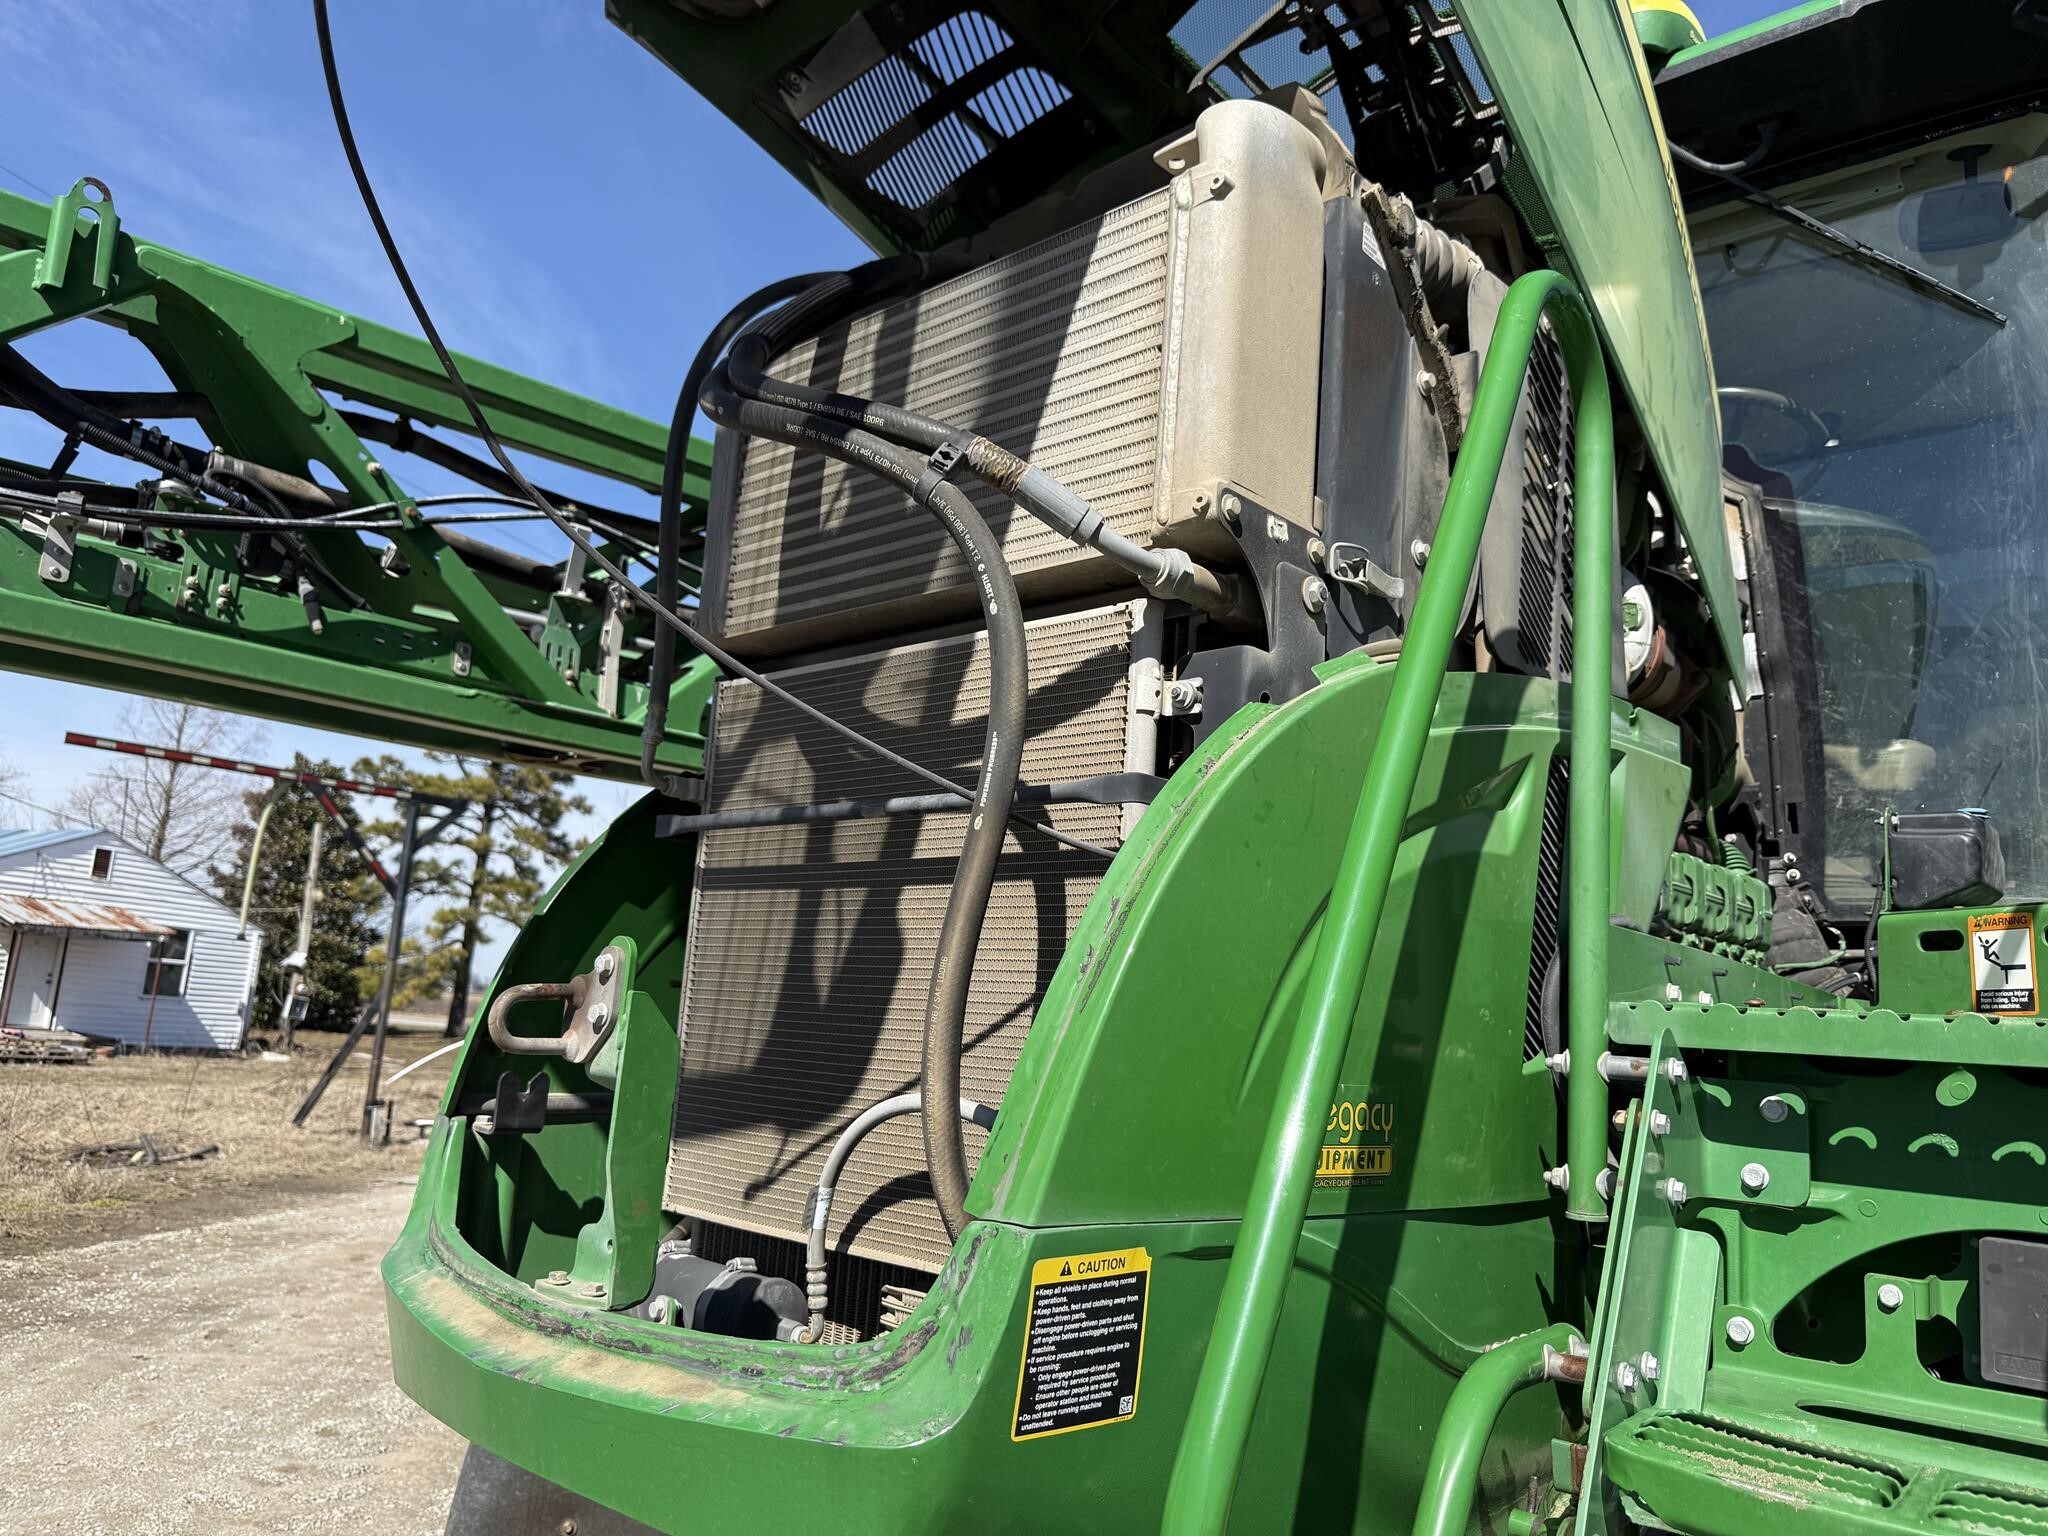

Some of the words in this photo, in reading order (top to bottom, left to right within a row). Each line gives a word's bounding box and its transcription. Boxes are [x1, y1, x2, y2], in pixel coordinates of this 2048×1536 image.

[849, 410, 862, 420] SAE
[862, 414, 884, 426] 100R6
[858, 445, 875, 460] Type
[873, 454, 892, 468] 4079
[890, 462, 904, 474] ISO
[942, 504, 958, 521] PSI)
[951, 518, 968, 536] (300
[961, 533, 977, 550] MPa
[979, 771, 991, 807] POWERING
[1984, 916, 2027, 926] WARNING
[936, 955, 948, 984] 100R6
[933, 986, 942, 1002] SAE
[930, 1010, 938, 1022] R6
[924, 1092, 934, 1114] 4079
[1327, 1102, 1393, 1143] egacy
[1318, 1150, 1385, 1170] IPMENT
[1078, 1257, 1126, 1274] CAUTION
[1040, 1288, 1053, 1296] Keep
[1062, 1285, 1081, 1293] shields
[1088, 1282, 1102, 1290] place
[1103, 1280, 1119, 1288] during
[1120, 1276, 1136, 1284] normal
[1037, 1308, 1051, 1316] Keep
[1052, 1305, 1070, 1313] hands,
[1081, 1301, 1091, 1309] and
[1092, 1299, 1113, 1308] clothing
[1038, 1296, 1068, 1306] operations.
[1035, 1315, 1071, 1326] power-driven
[1072, 1312, 1086, 1321] parts.
[1035, 1325, 1063, 1335] Disengage
[1064, 1320, 1098, 1331] power-driven
[1099, 1318, 1112, 1326] parts
[1042, 1335, 1060, 1344] engine
[1061, 1331, 1078, 1340] before
[1079, 1328, 1108, 1338] unclogging
[1115, 1322, 1138, 1332] servicing
[1032, 1345, 1056, 1354] machine.
[1036, 1354, 1055, 1362] service
[1056, 1350, 1084, 1361] procedure
[1085, 1346, 1106, 1356] requires
[1107, 1344, 1123, 1352] engine
[1037, 1363, 1061, 1372] running:
[1038, 1374, 1050, 1382] Only
[1052, 1371, 1072, 1381] engage
[1073, 1364, 1106, 1375] power-driven
[1107, 1362, 1120, 1370] parts
[1038, 1382, 1061, 1391] required
[1070, 1377, 1088, 1385] service
[1090, 1372, 1117, 1382] procedure.
[1035, 1392, 1055, 1401] Ensure
[1071, 1386, 1089, 1395] people
[1035, 1401, 1059, 1410] operator
[1090, 1391, 1113, 1399] machine.
[1042, 1410, 1057, 1418] leave
[1058, 1406, 1079, 1415] running
[1080, 1401, 1102, 1411] machine
[1021, 1420, 1054, 1431] unattended.
